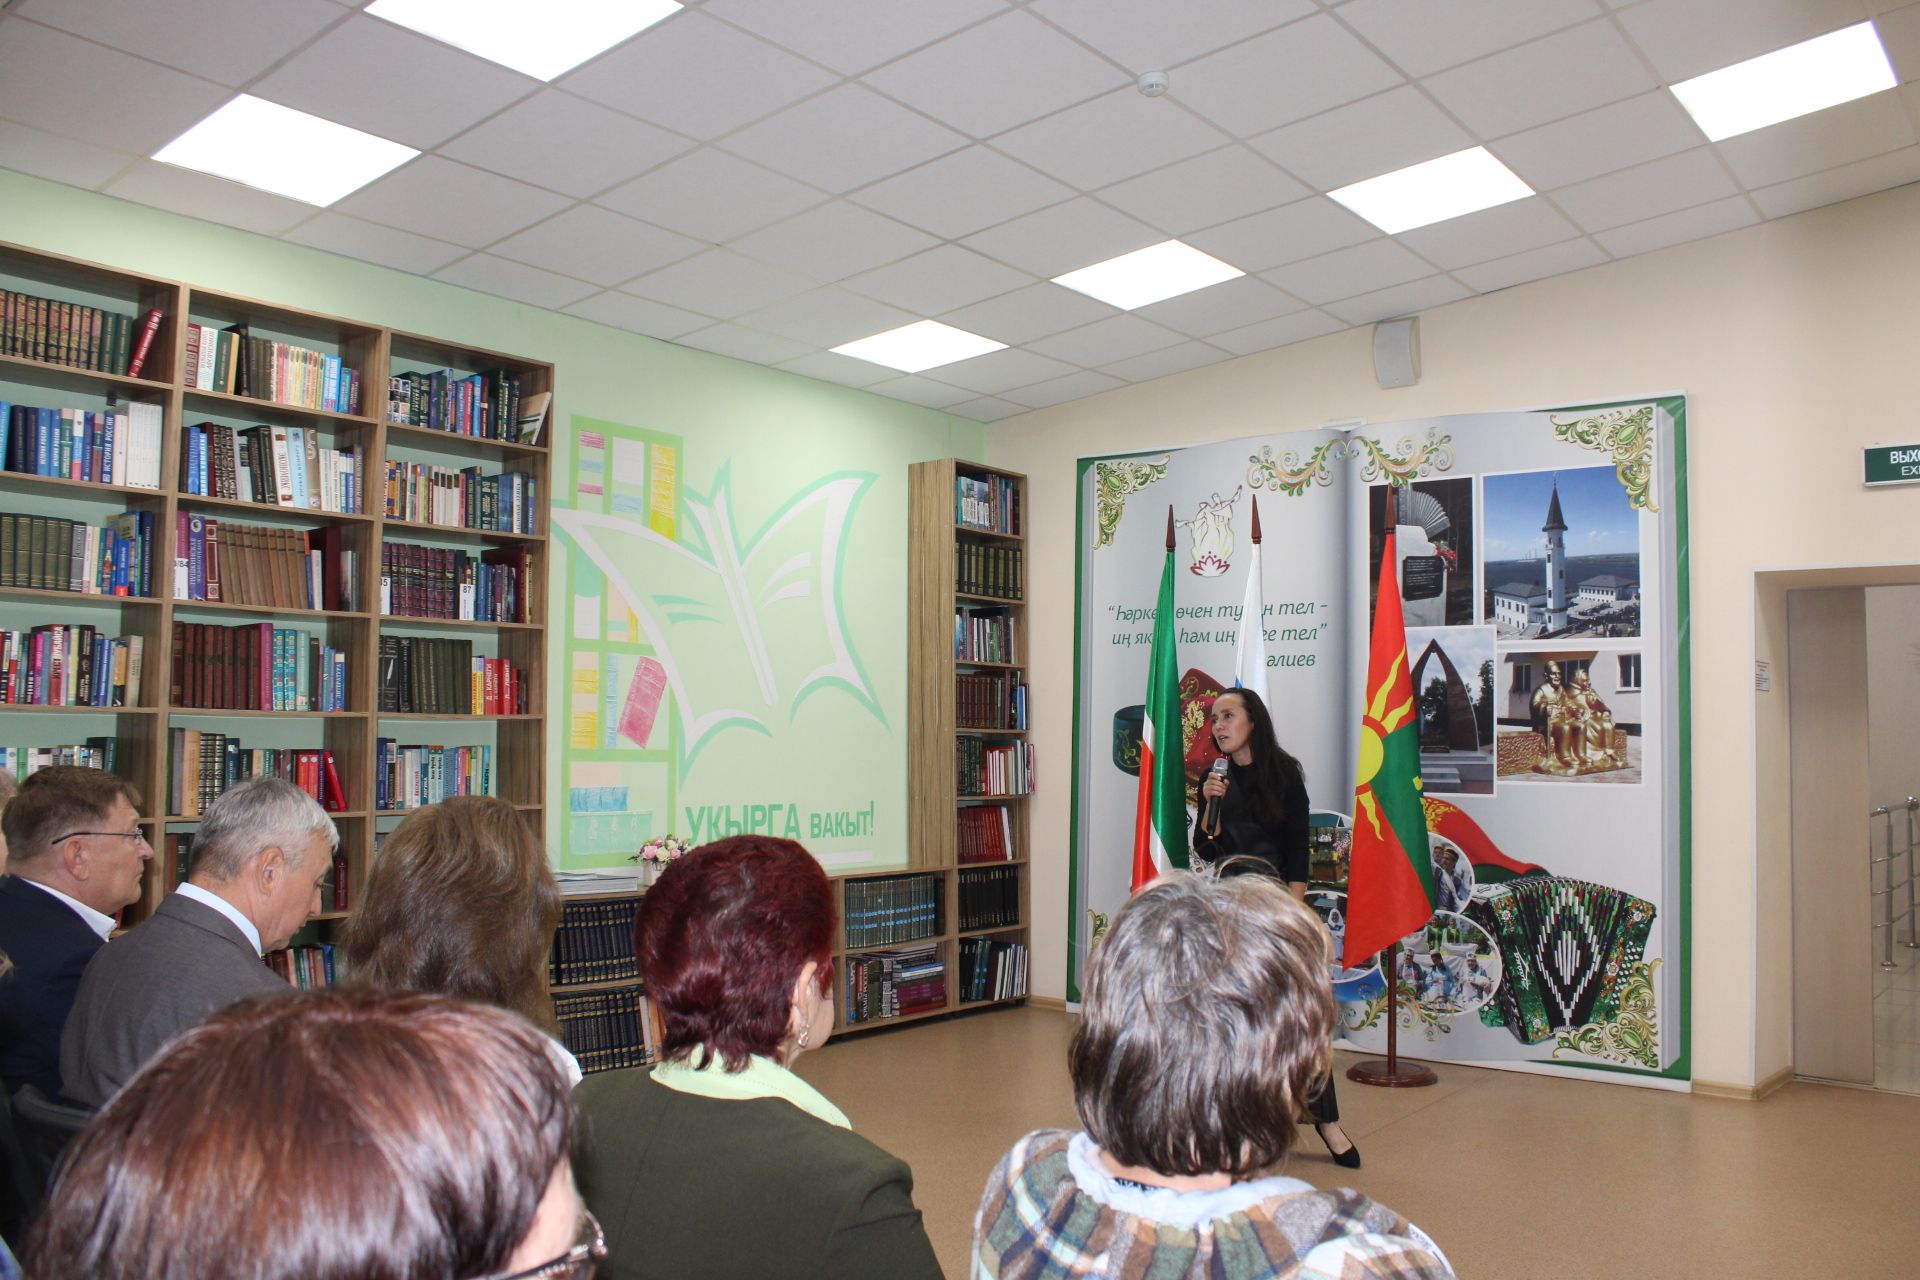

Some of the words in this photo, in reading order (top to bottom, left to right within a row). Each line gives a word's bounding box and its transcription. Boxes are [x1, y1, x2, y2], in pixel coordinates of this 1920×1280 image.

[105, 416, 114, 441] РОССИИ
[103, 443, 113, 472] ИСТОРИЯ
[1890, 449, 1920, 464] ВЫХ
[189, 537, 197, 585] ПУШКИНСКАЯ
[463, 585, 472, 594] 87
[1176, 606, 1213, 619] өчен
[1217, 603, 1273, 621] тун
[1278, 602, 1315, 615] тел
[1112, 633, 1131, 648] иң
[1134, 632, 1153, 645] як
[1179, 627, 1211, 644] һәм
[1215, 631, 1236, 646] иң
[1281, 623, 1328, 641] тел”
[1266, 654, 1316, 667] әлиев
[684, 803, 802, 846] УКЫРГА
[810, 799, 875, 838] ВАКЫТ!
